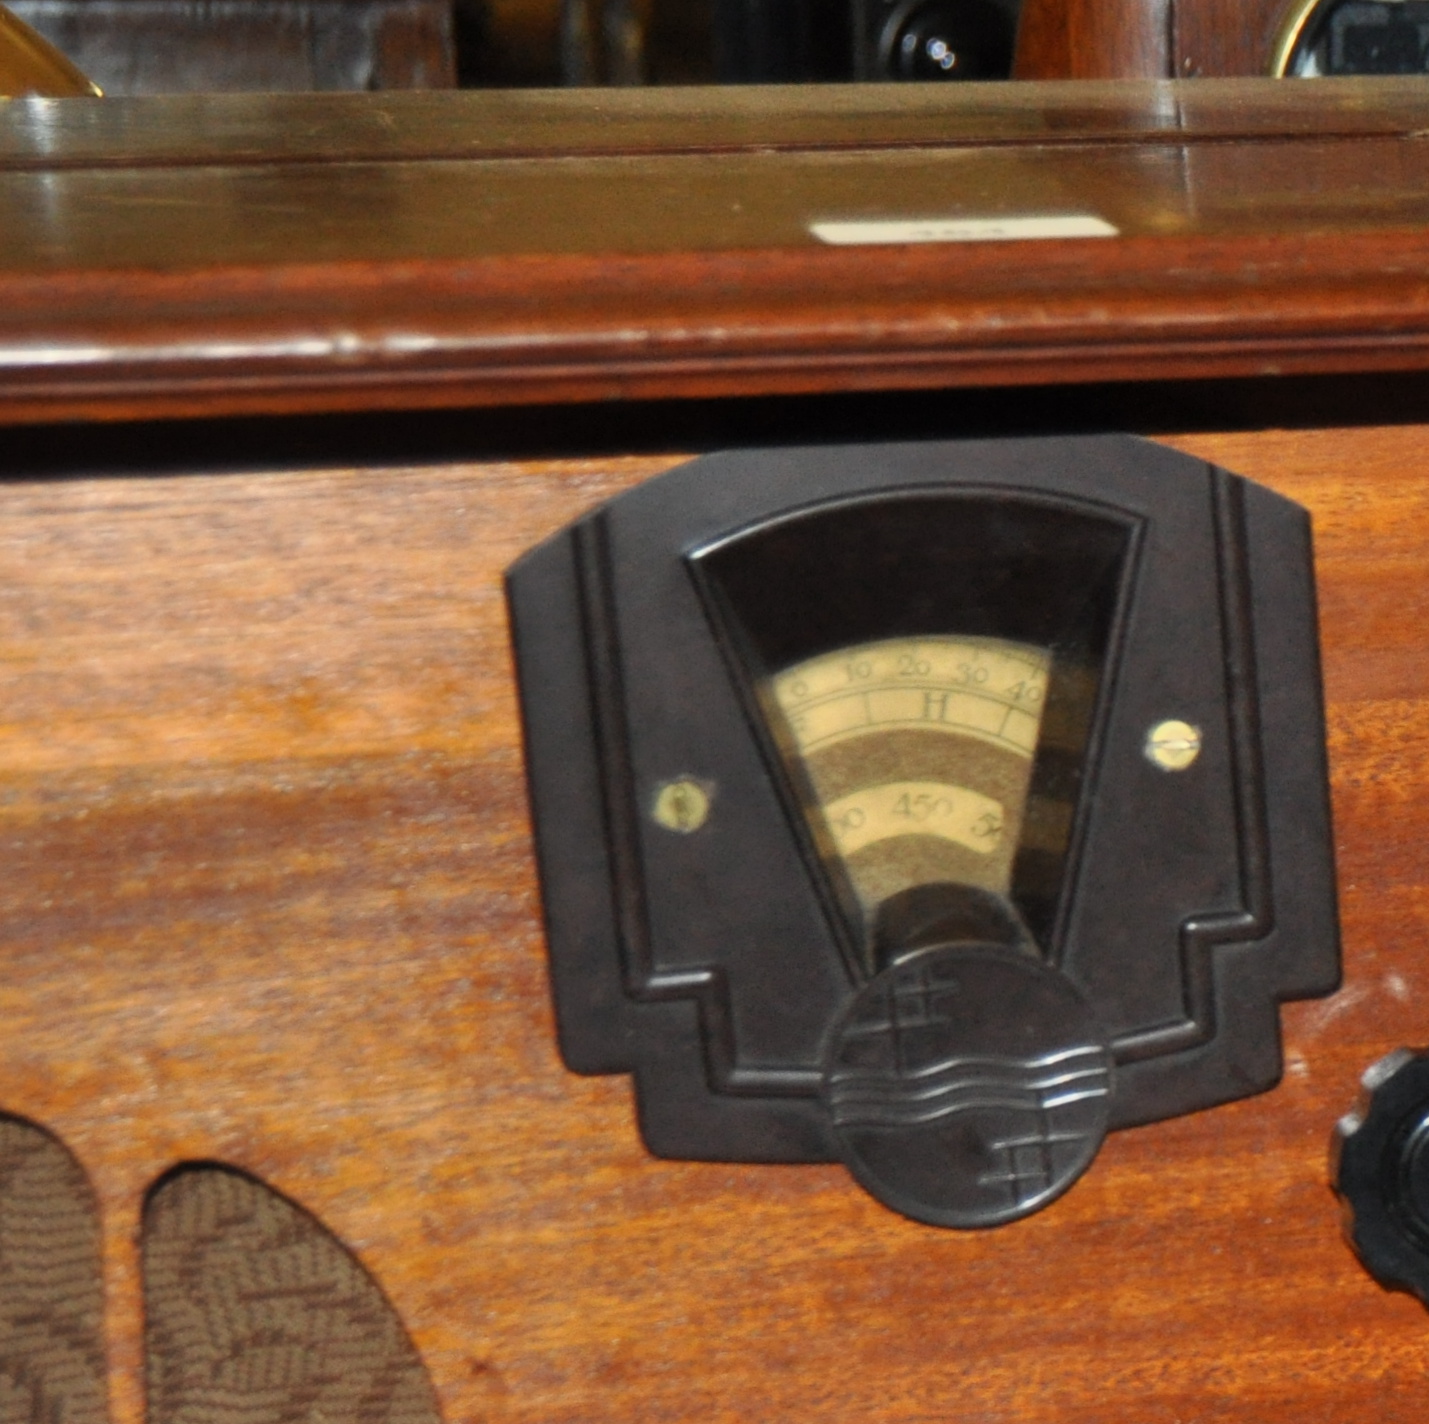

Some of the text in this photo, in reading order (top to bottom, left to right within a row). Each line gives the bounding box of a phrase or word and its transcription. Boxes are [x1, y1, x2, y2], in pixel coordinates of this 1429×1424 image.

[843, 660, 873, 682] 10
[897, 654, 932, 677] 20
[952, 662, 990, 685] 30
[1003, 679, 1042, 703] 40
[923, 692, 947, 719] H
[891, 792, 954, 823] 450
